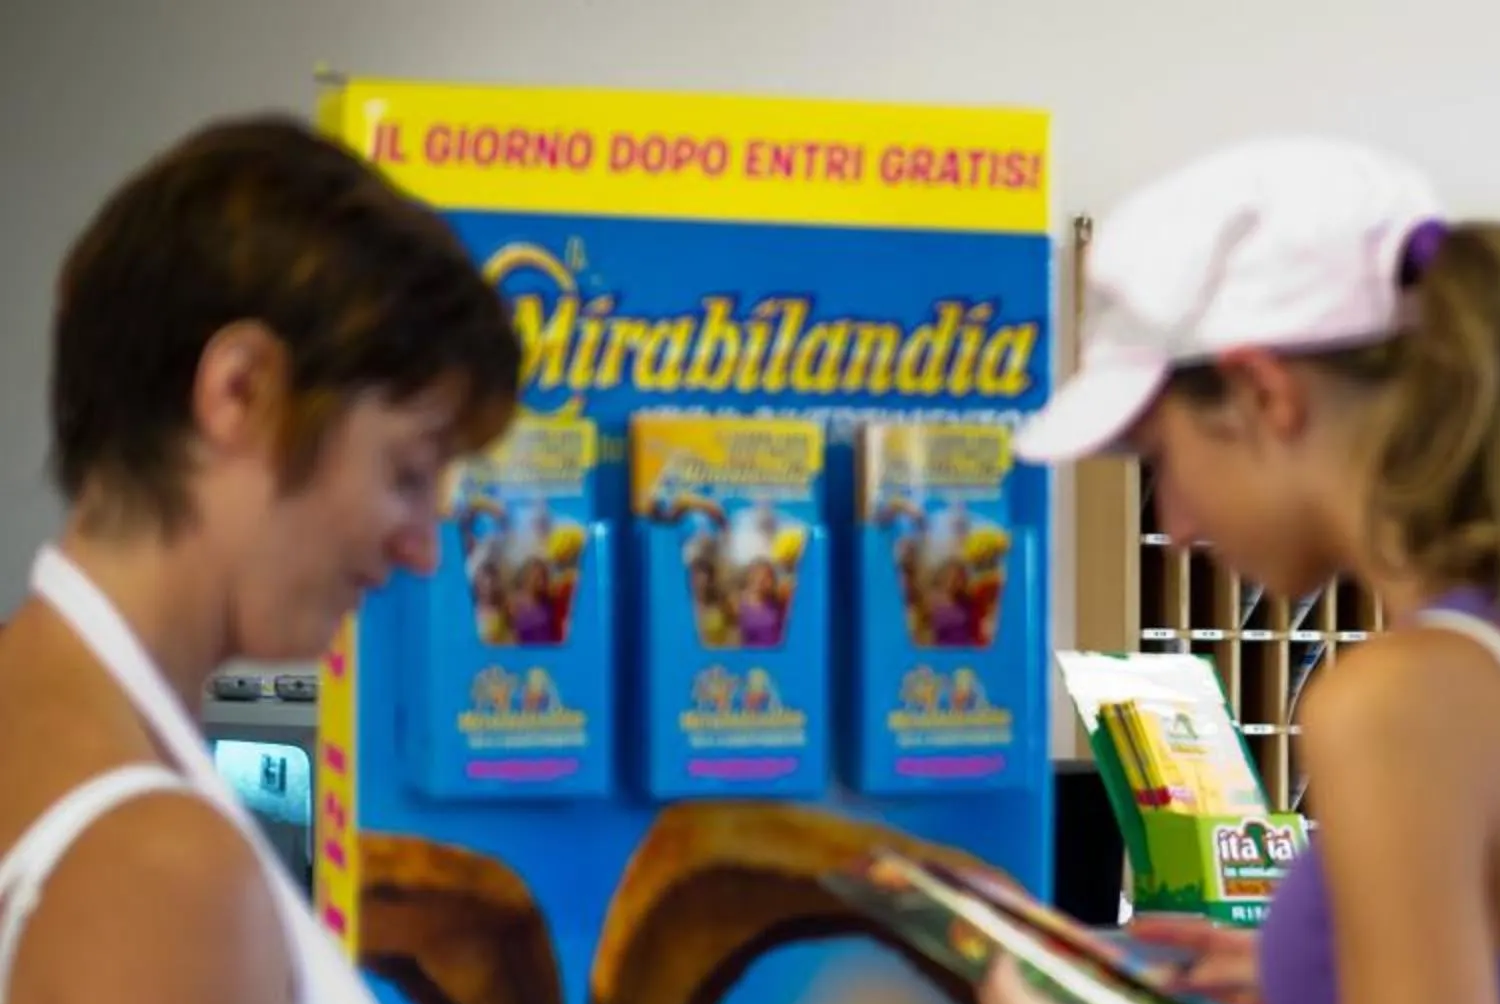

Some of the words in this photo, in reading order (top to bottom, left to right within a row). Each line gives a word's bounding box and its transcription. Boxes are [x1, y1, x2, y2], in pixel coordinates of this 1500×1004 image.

[372, 118, 407, 163] IL
[424, 120, 595, 172] GIORNO
[608, 133, 730, 178] DOPO
[743, 140, 864, 184] ENTRI
[879, 146, 1041, 190] GRATIS!
[485, 243, 1038, 398] Mirabilandia
